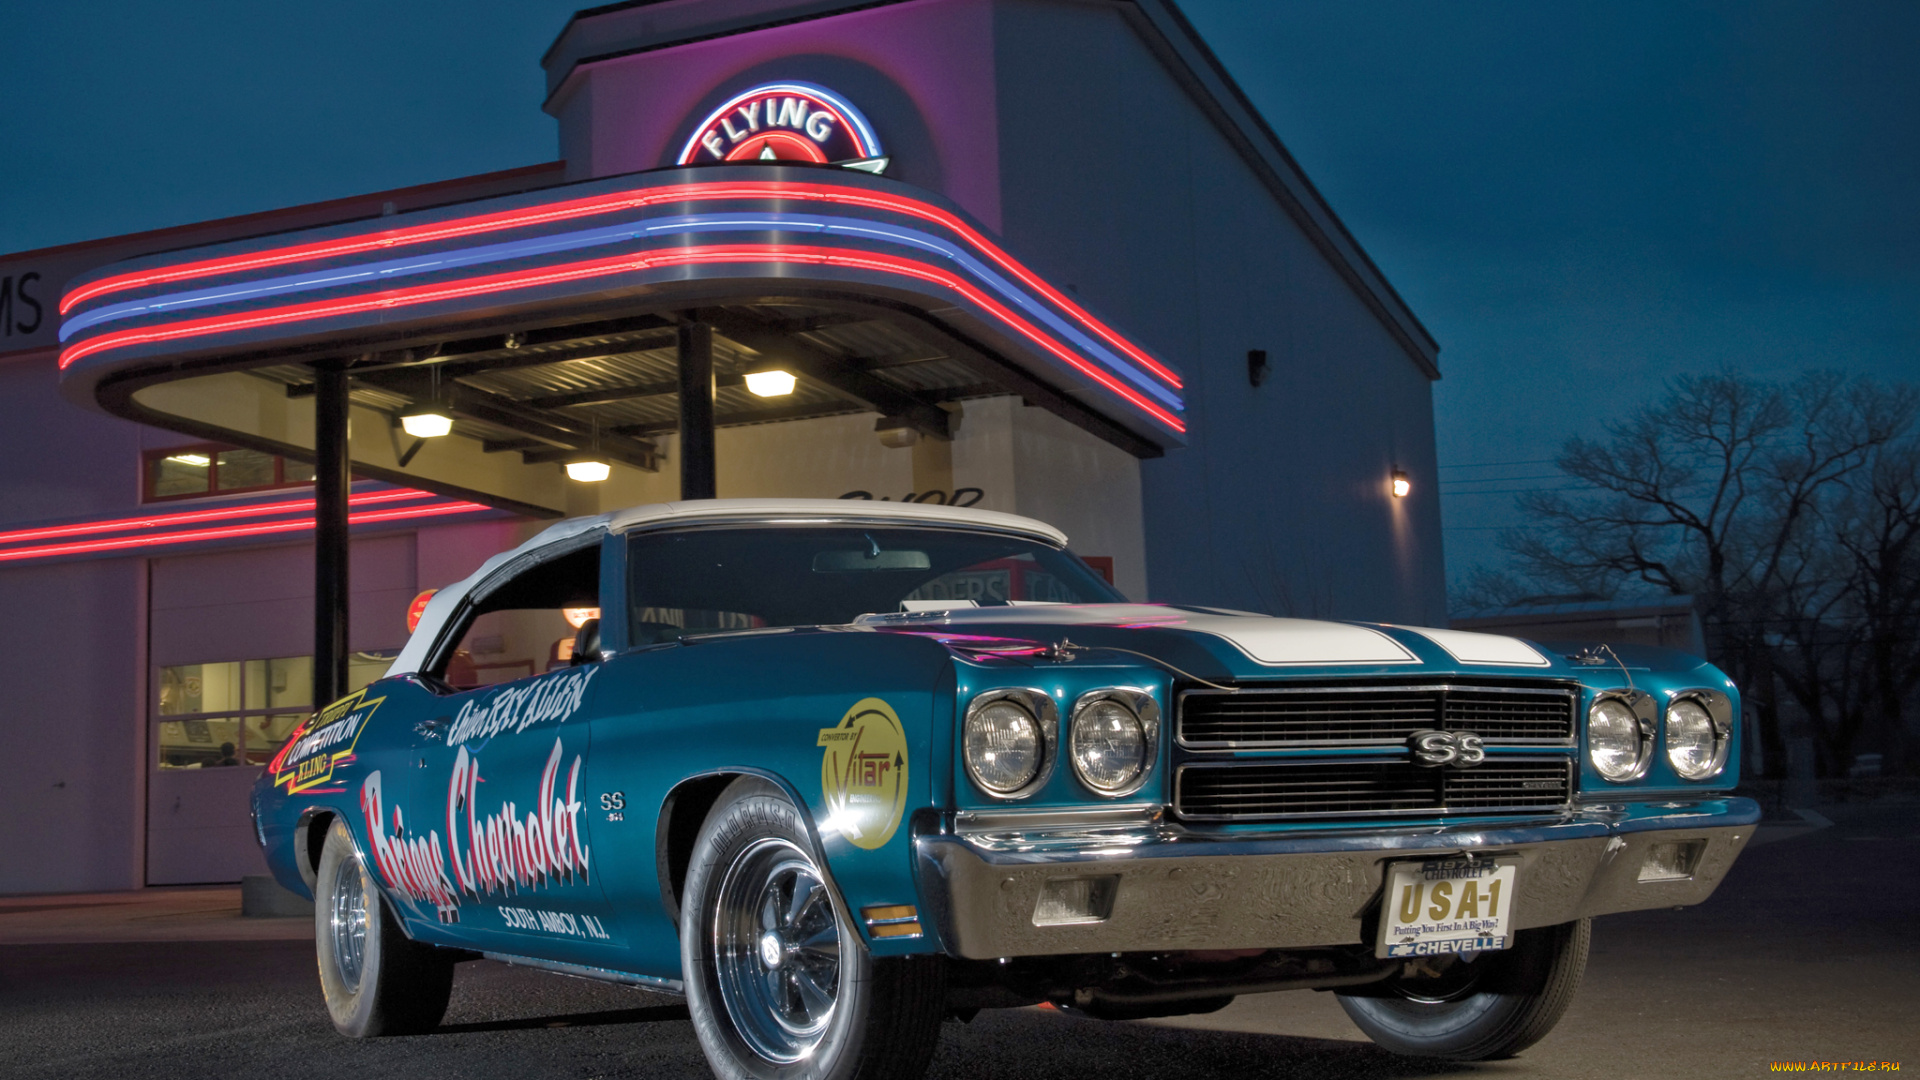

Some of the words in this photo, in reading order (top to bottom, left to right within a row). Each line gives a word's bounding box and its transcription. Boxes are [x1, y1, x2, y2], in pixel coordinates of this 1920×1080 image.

[701, 97, 836, 160] FLYING
[480, 678, 541, 738] RAY
[516, 666, 599, 734] ALLEN
[287, 713, 362, 765] COMPETITION
[1410, 732, 1485, 766] SS
[296, 753, 327, 782] KLING
[832, 725, 890, 812] Vitar
[600, 791, 625, 811] SS
[446, 736, 590, 904] Chevrolet
[710, 802, 797, 857] MOROSO
[1425, 867, 1483, 881] CHEVROLET
[498, 905, 541, 931] SOUTH
[1393, 925, 1421, 937] Putting
[1421, 923, 1435, 933] You
[1436, 922, 1453, 932] First
[1454, 921, 1462, 930] In
[1462, 921, 1469, 930] A
[1469, 920, 1482, 932] Big
[1414, 937, 1503, 955] CHEVELLE
